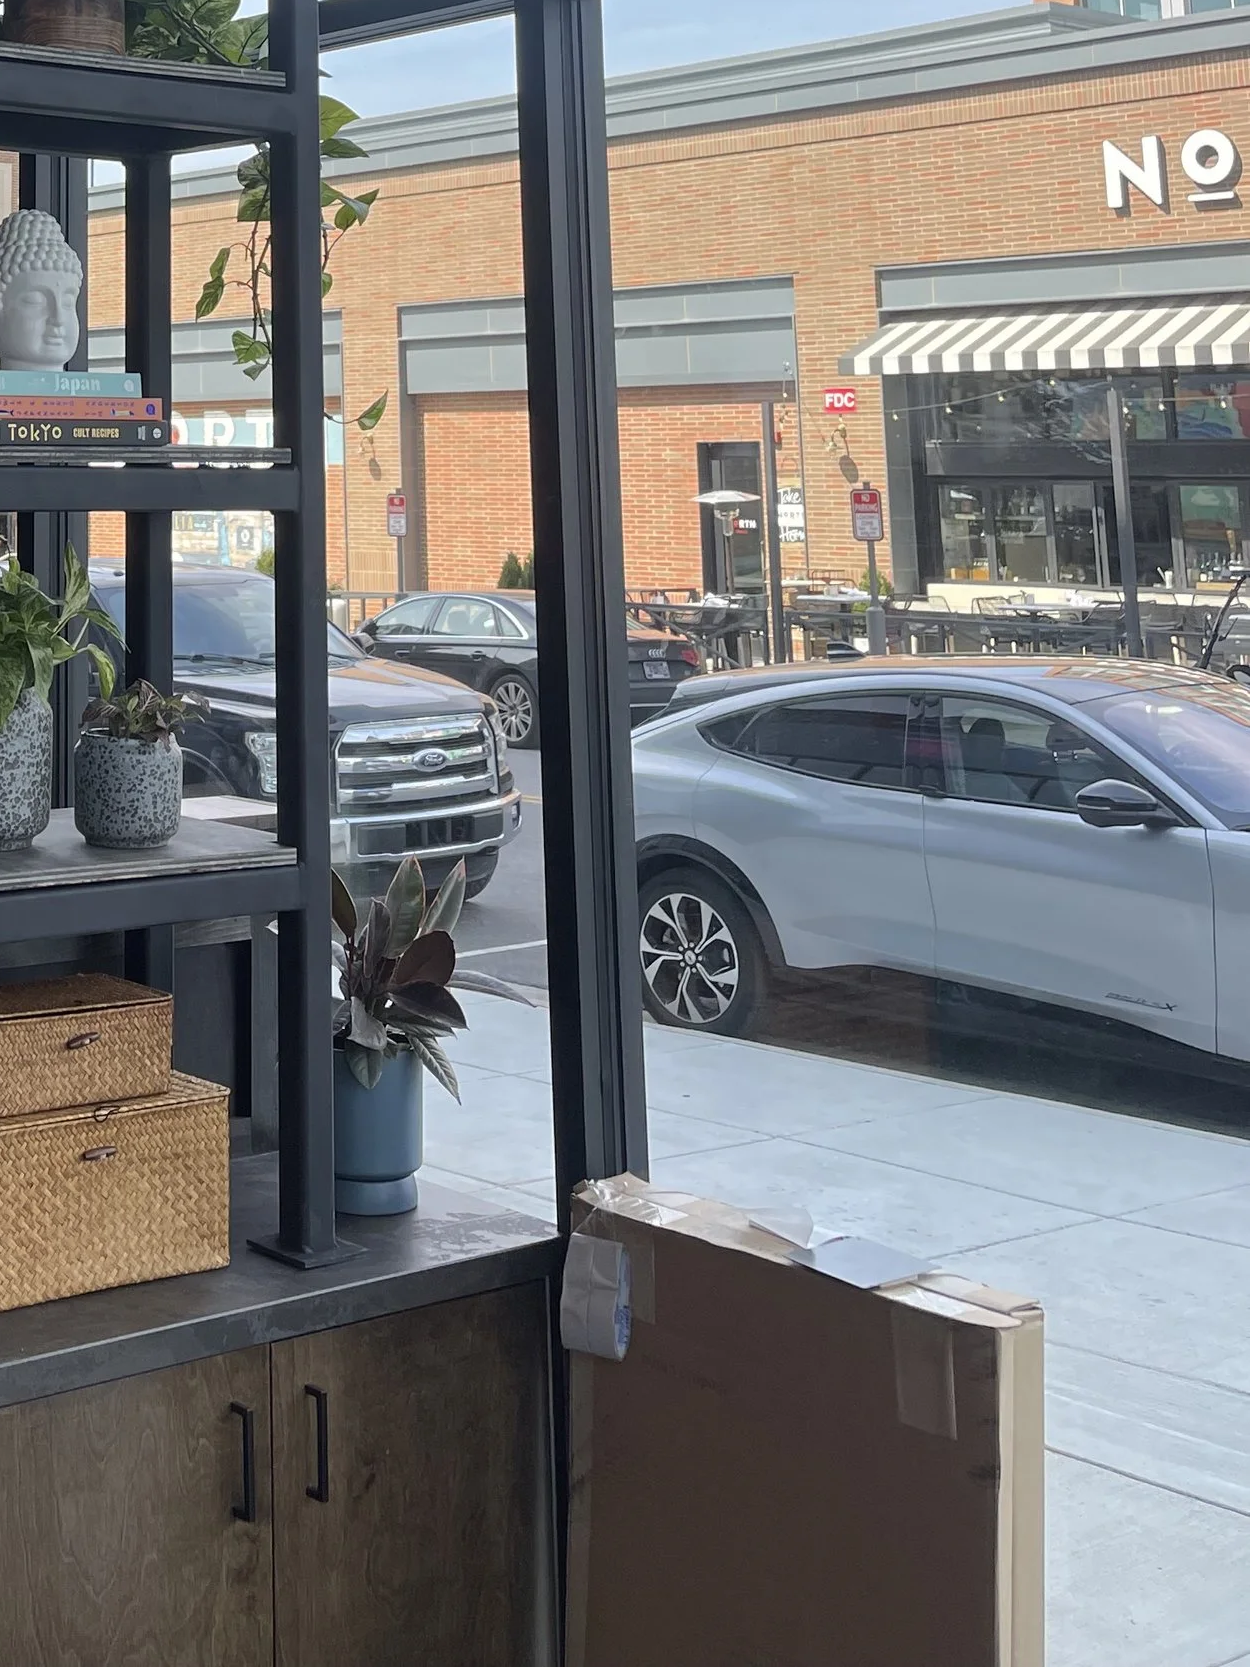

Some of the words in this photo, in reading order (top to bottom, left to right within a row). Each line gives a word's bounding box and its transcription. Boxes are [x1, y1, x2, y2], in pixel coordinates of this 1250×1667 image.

[54, 374, 101, 396] Japan
[825, 392, 855, 408] FDC
[73, 427, 90, 439] CULT
[91, 427, 120, 439] RECIPES
